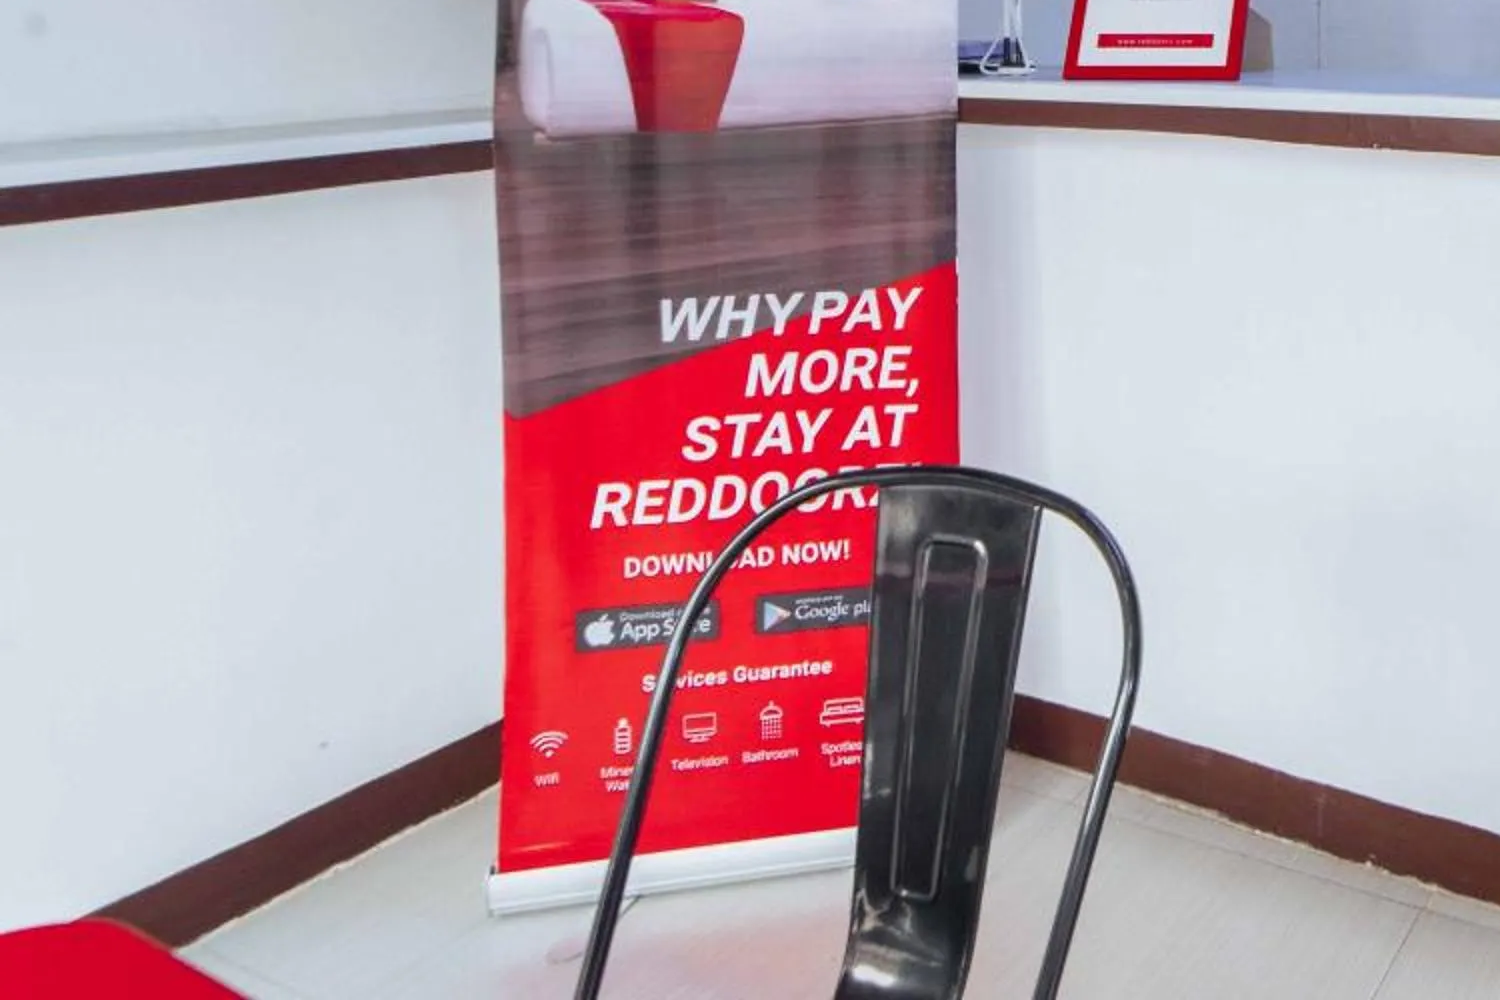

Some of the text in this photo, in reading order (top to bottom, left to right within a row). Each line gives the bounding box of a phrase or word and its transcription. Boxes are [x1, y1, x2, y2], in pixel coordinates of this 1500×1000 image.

[660, 286, 925, 343] WHY PAY
[744, 345, 920, 398] MORE,
[681, 404, 919, 462] STAY AT
[623, 539, 850, 578] DOWNLAD NOW!
[794, 601, 850, 621] Google
[620, 621, 660, 642] App
[642, 660, 833, 692] Svices Guarantee
[671, 755, 729, 771] Television
[742, 748, 799, 764] Bathroom
